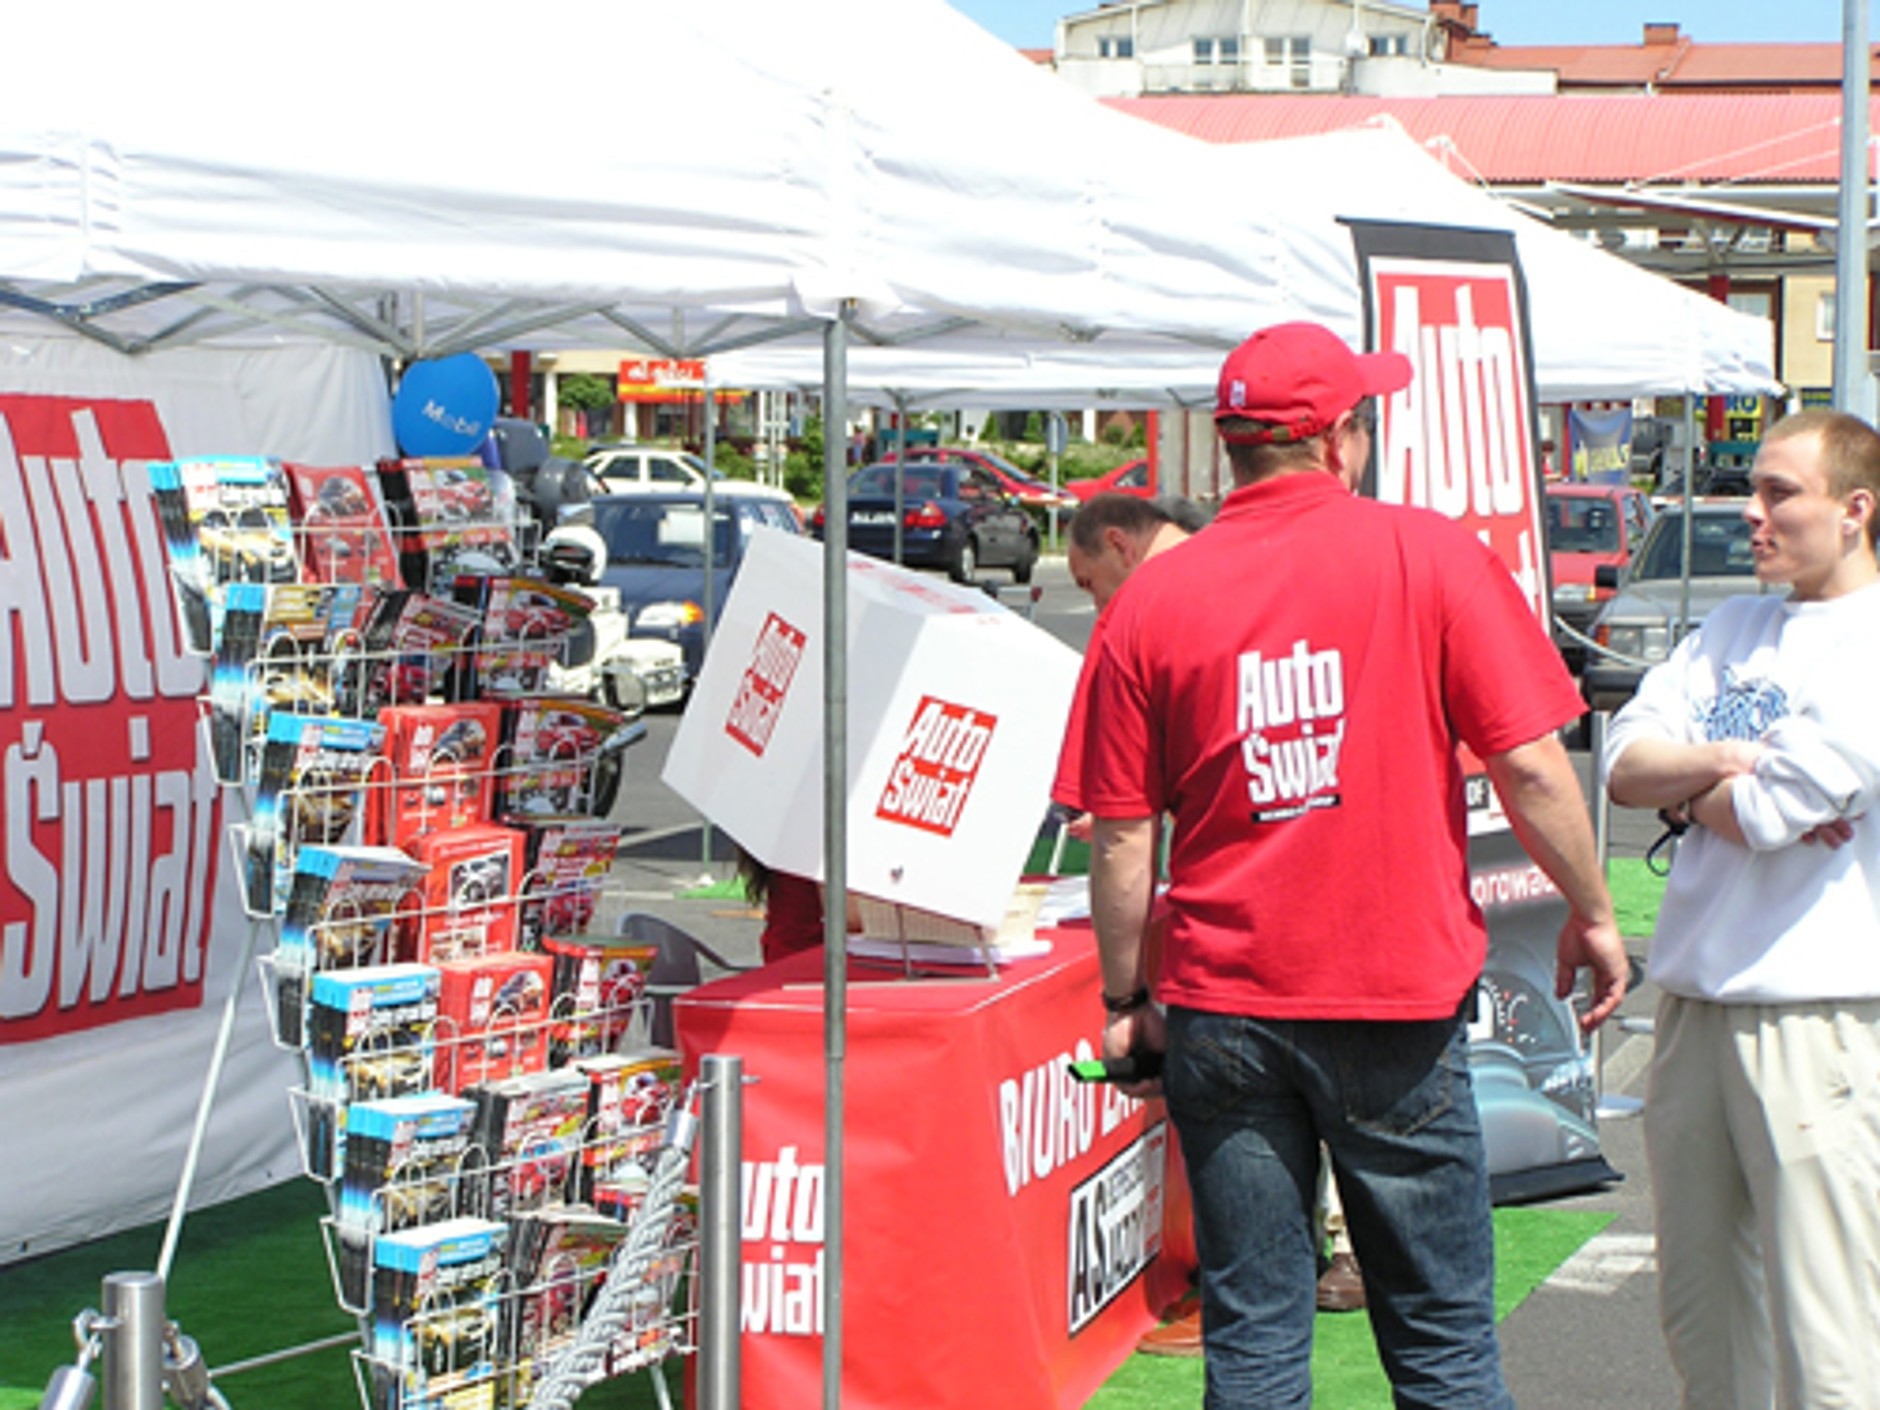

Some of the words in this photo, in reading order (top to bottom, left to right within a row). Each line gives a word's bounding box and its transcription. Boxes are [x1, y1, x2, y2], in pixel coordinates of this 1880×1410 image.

[1378, 284, 1524, 519] Auto
[903, 702, 992, 772] Auto
[1237, 639, 1344, 733] Auto
[882, 758, 970, 827] Świat
[3, 716, 220, 1020] Świat
[999, 1038, 1095, 1198] BIURO
[741, 1146, 826, 1243] uto
[1071, 1180, 1107, 1324] AS
